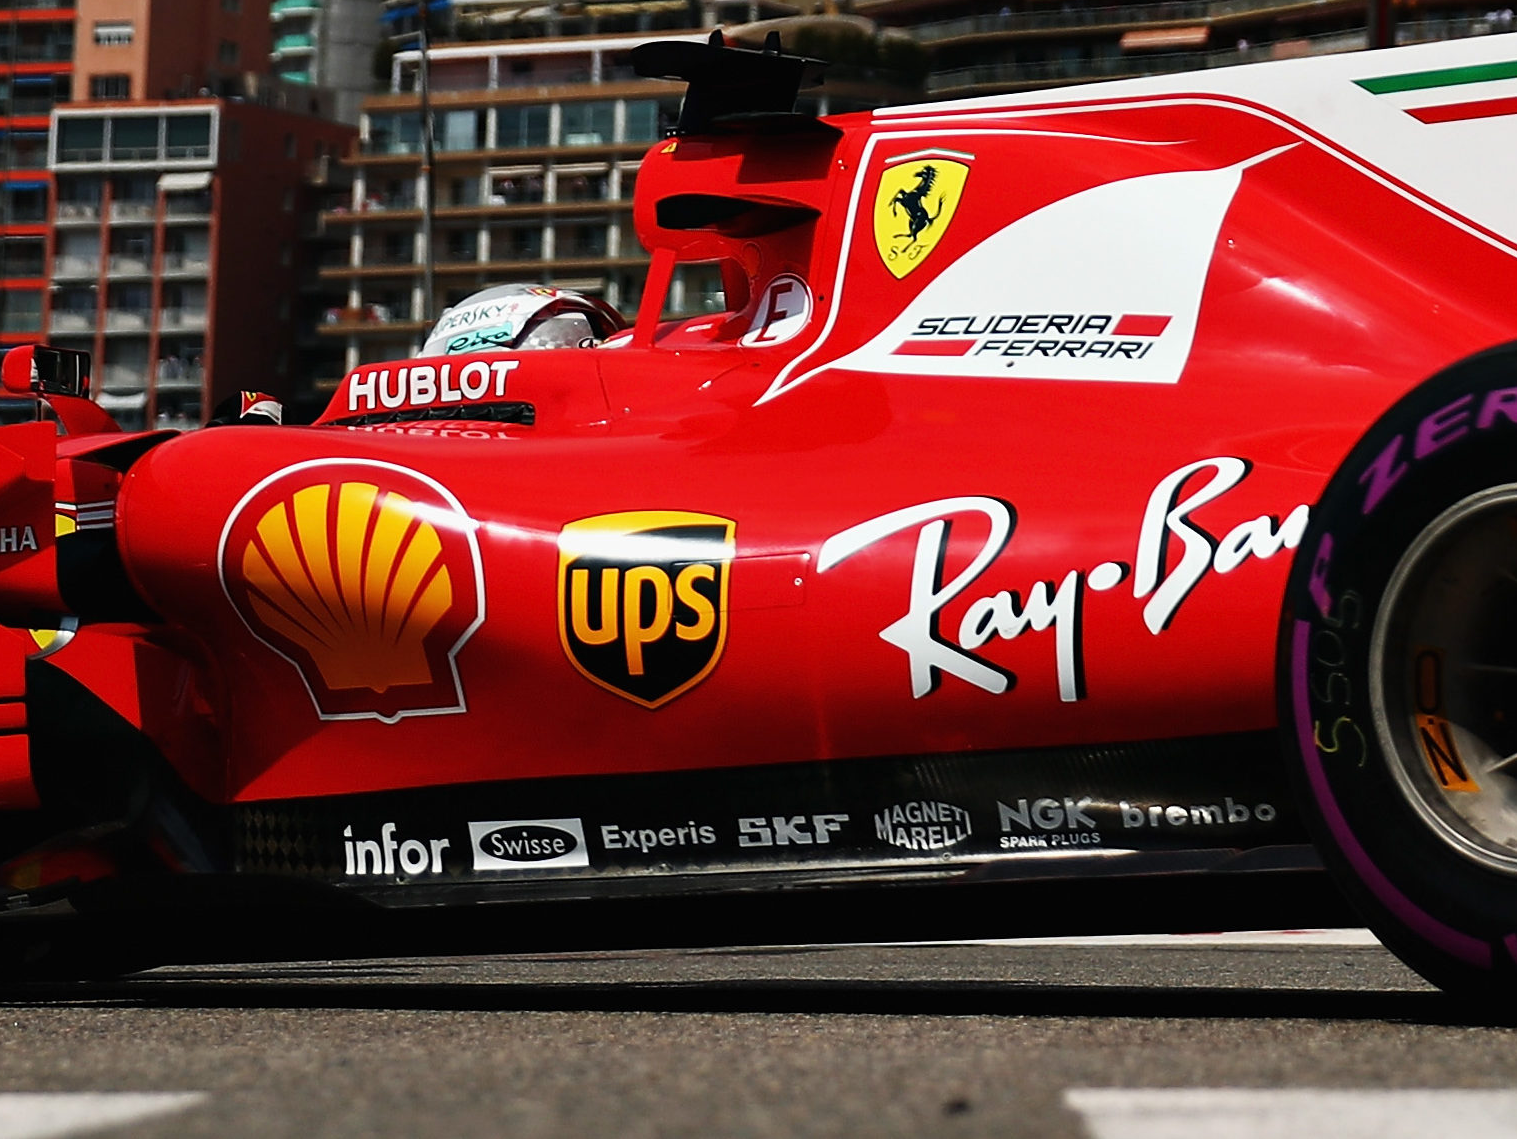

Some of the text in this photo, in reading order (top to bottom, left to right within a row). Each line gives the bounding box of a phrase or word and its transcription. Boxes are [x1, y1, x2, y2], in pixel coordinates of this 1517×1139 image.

[753, 282, 793, 343] E
[911, 314, 1113, 336] SCUDERIA
[973, 339, 1155, 359] FERRARI
[348, 360, 520, 411] HUBLOT
[570, 563, 717, 676] ups
[997, 797, 1096, 832] NGK
[1122, 797, 1276, 829] brembo
[491, 831, 565, 857] Swisse
[601, 821, 716, 852] Experis
[738, 814, 849, 848] SKF
[1000, 832, 1101, 848] SPARK PLUGS
[344, 822, 449, 875] infor
